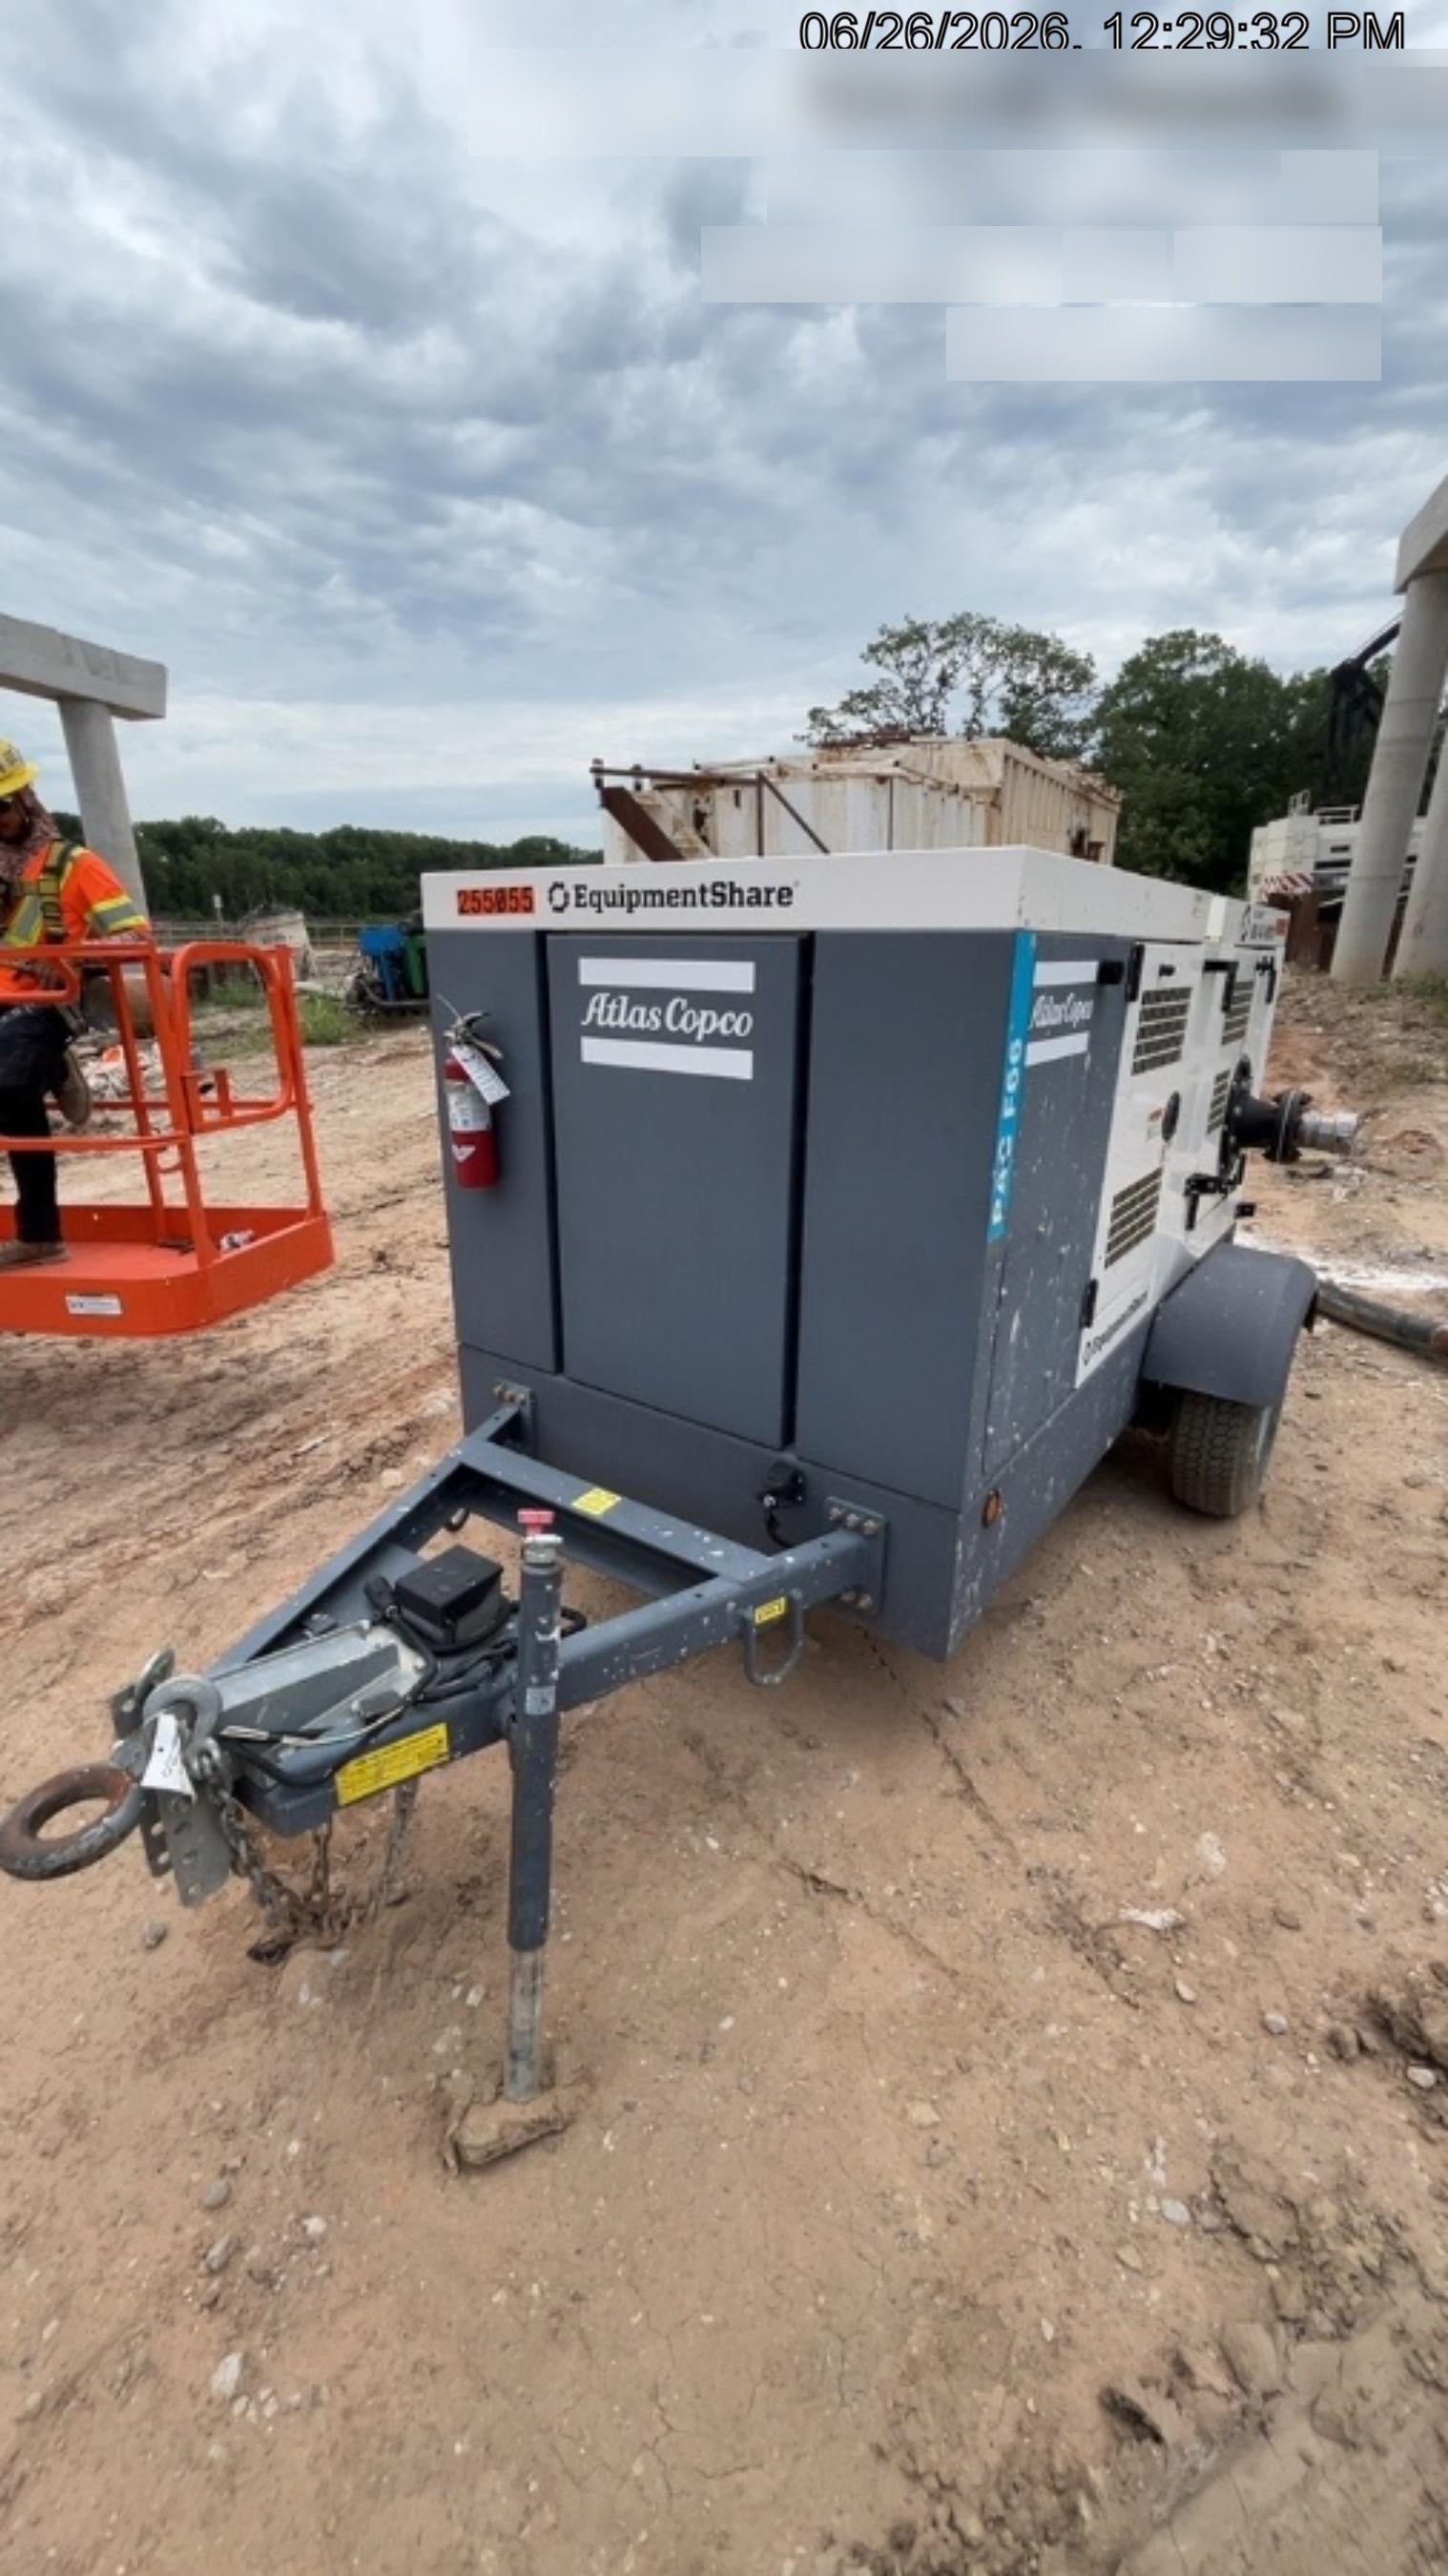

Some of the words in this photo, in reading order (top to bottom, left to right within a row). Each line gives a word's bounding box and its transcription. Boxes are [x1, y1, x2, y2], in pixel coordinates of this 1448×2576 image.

[573, 881, 794, 913] EquipmentShare
[580, 992, 663, 1031] Atlas
[665, 996, 755, 1043] Copco
